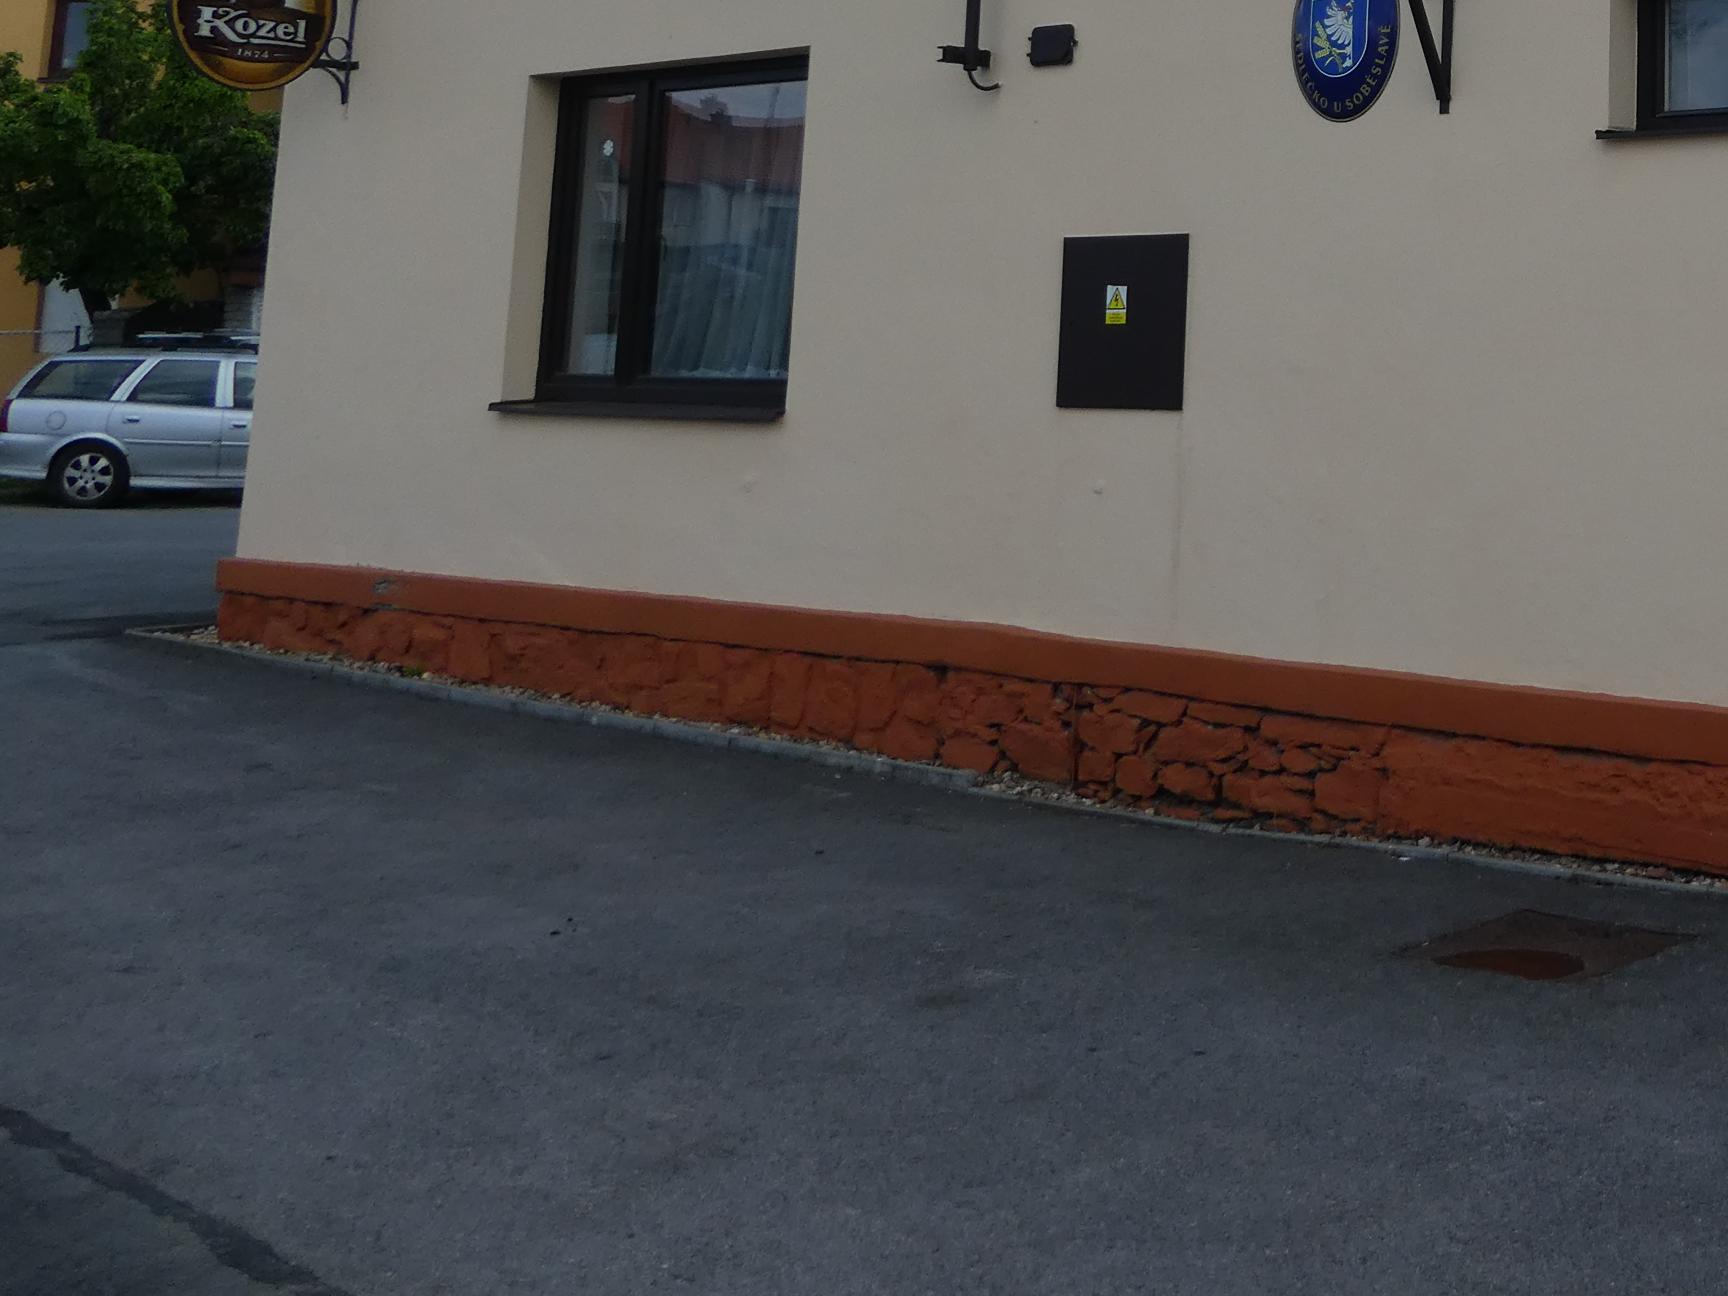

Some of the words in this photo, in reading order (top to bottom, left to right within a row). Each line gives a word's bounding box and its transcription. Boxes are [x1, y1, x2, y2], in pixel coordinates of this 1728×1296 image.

[194, 5, 307, 48] Kozel
[237, 48, 270, 58] 1874
[1334, 100, 1342, 113] U
[1345, 24, 1392, 111] SOBĚSLAVĚ
